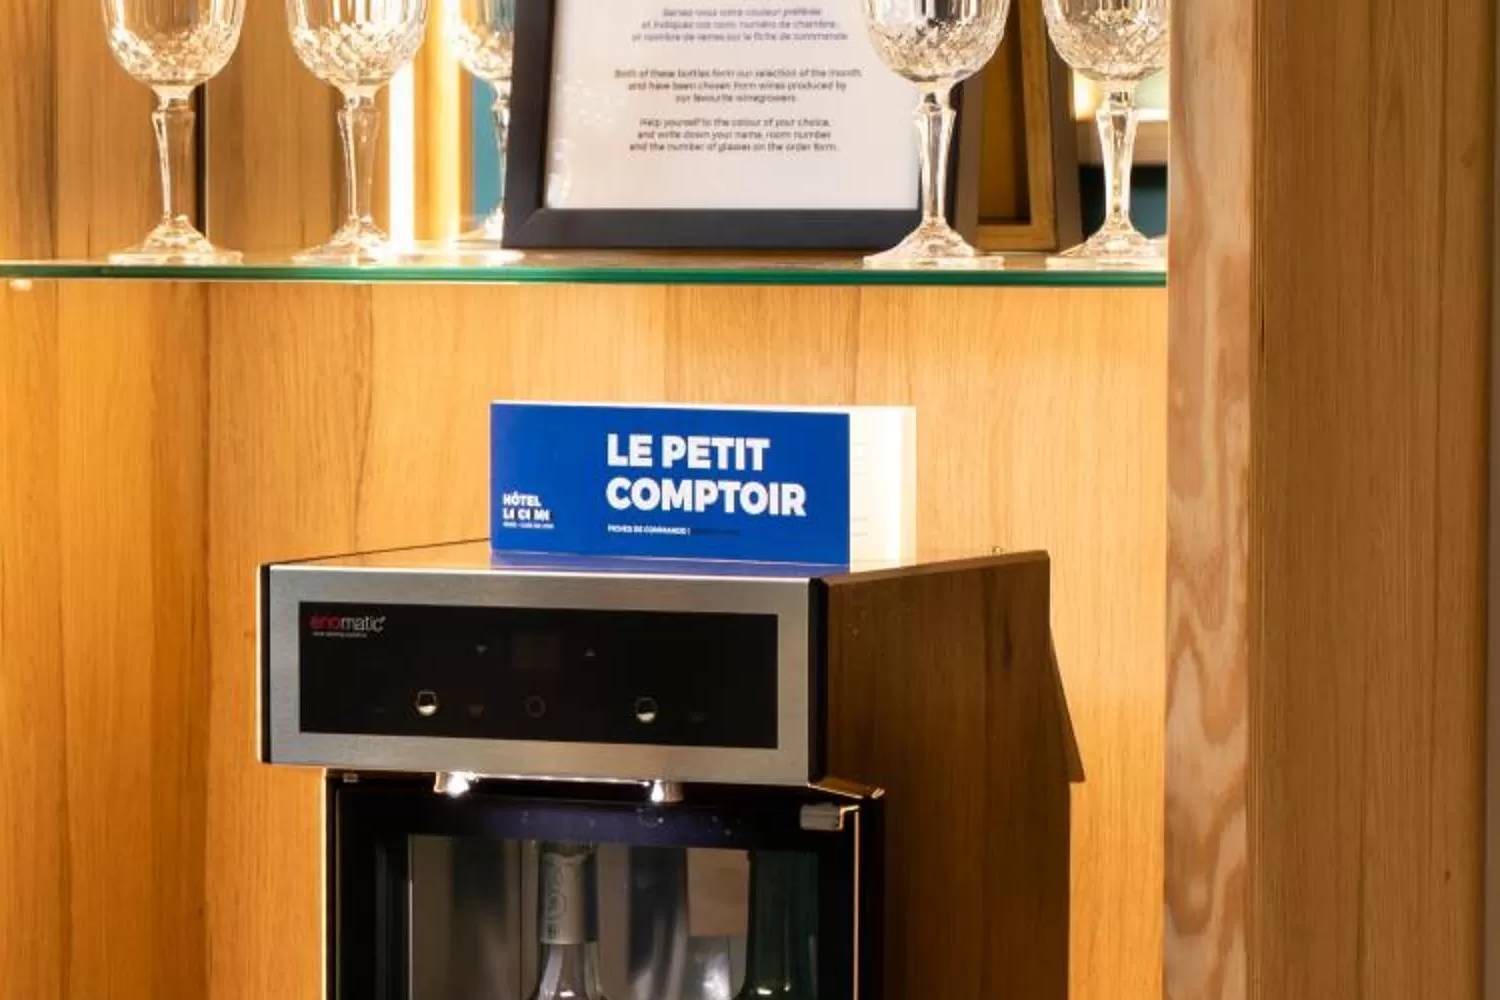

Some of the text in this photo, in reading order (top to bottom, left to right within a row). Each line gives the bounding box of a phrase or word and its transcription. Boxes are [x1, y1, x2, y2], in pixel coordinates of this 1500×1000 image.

[608, 434, 769, 470] LE PETIT
[502, 491, 543, 507] HÔTEL
[607, 478, 805, 515] COMPTOIR
